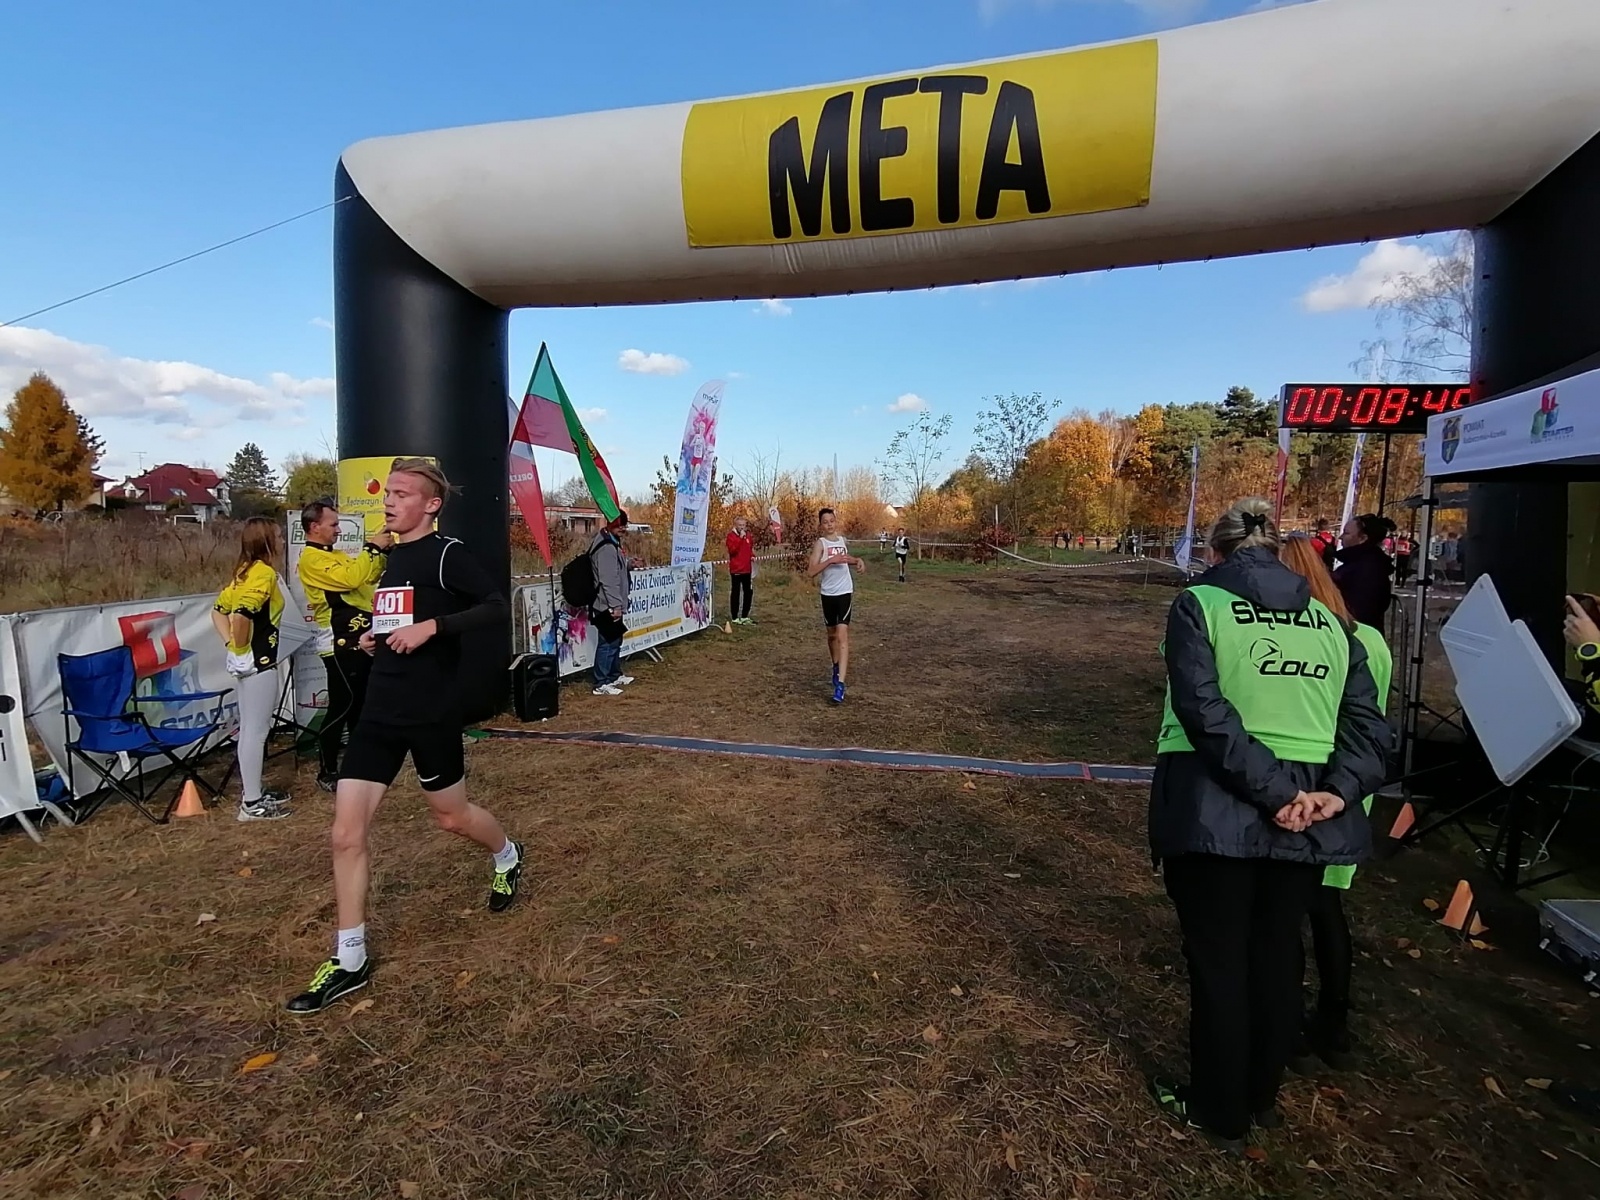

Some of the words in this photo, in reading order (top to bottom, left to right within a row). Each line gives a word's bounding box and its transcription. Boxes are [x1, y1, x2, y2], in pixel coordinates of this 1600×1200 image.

[768, 75, 1051, 239] META
[648, 570, 676, 590] Związek
[376, 592, 404, 614] 401
[650, 590, 676, 610] Atletyki
[376, 618, 401, 628] STARTER
[1259, 660, 1330, 680] COLO
[160, 702, 240, 729] START
